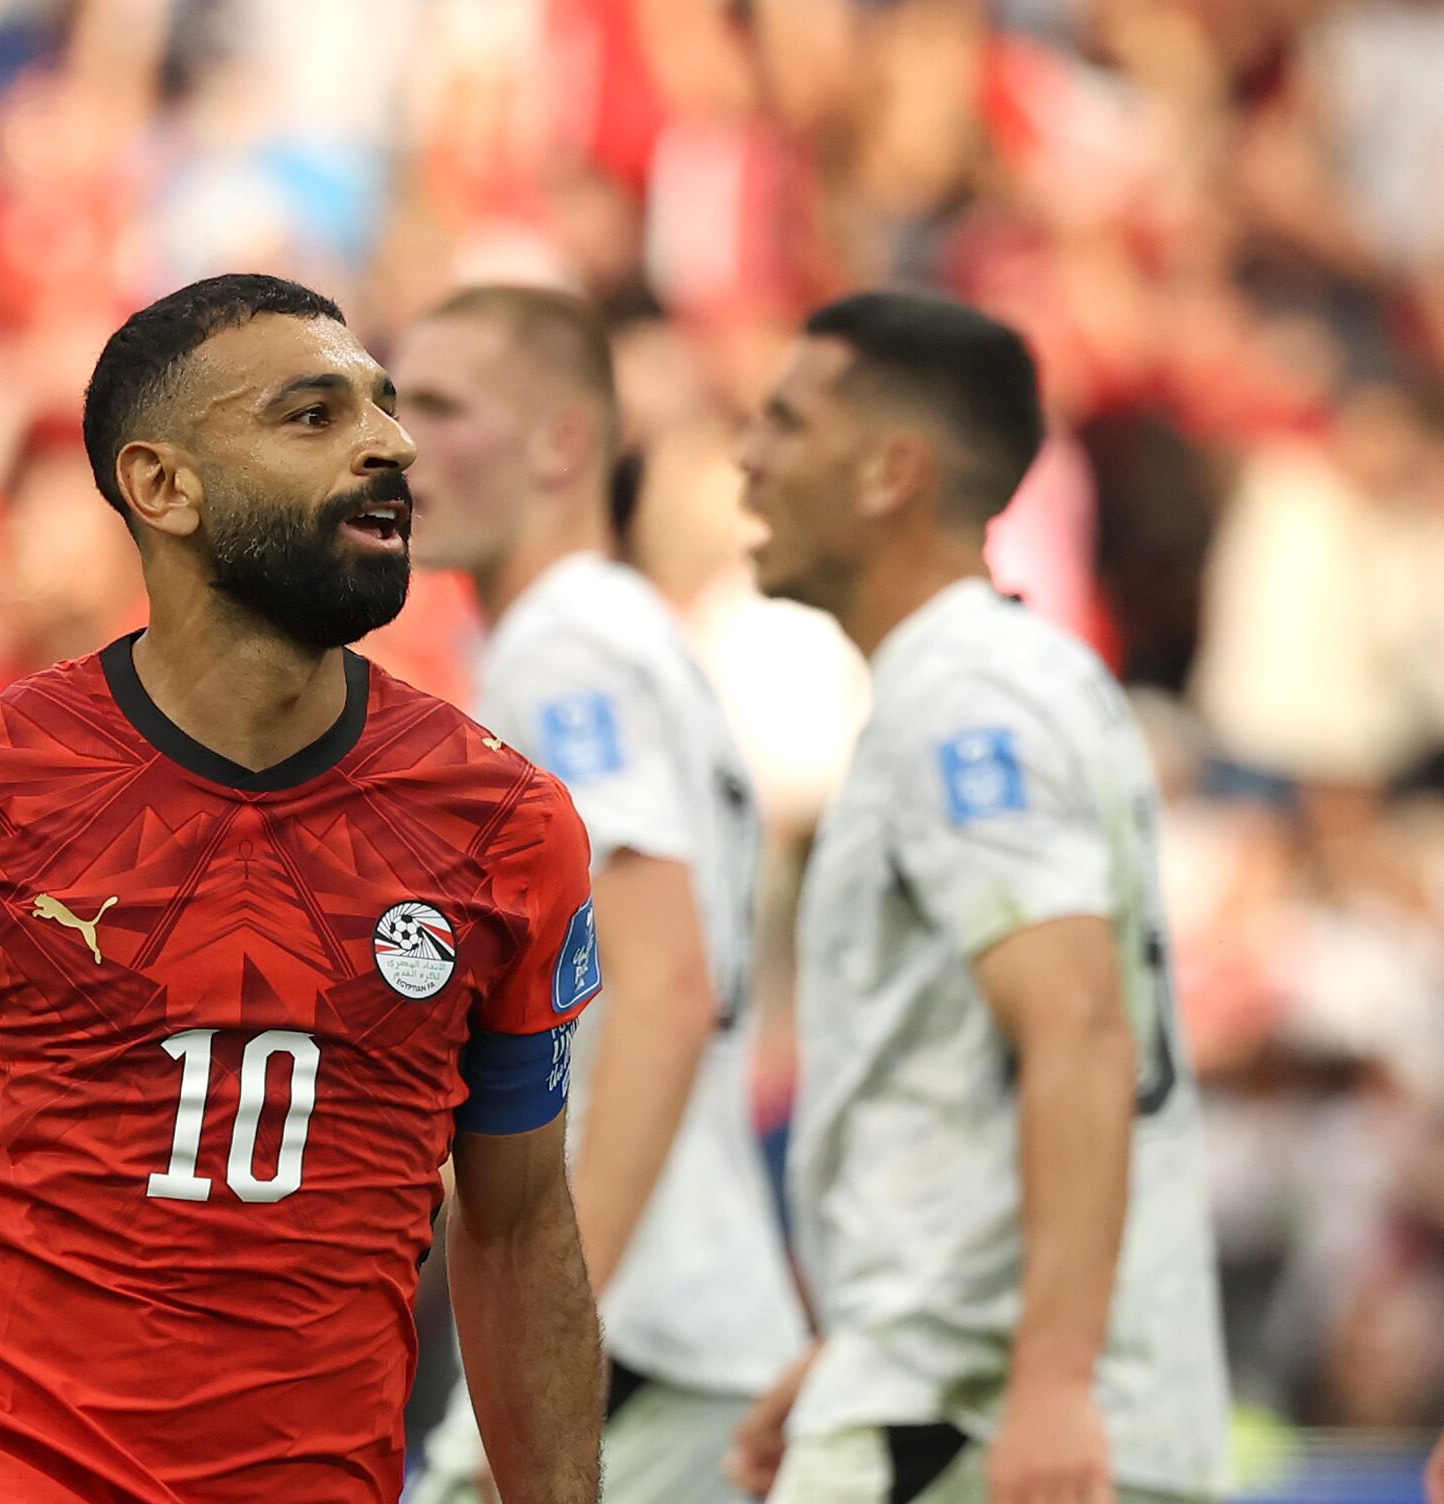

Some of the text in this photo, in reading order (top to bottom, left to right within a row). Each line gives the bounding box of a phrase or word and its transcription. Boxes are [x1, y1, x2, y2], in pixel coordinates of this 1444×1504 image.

[396, 978, 436, 992] EGYPTIAN FA
[146, 1028, 320, 1202] 10
